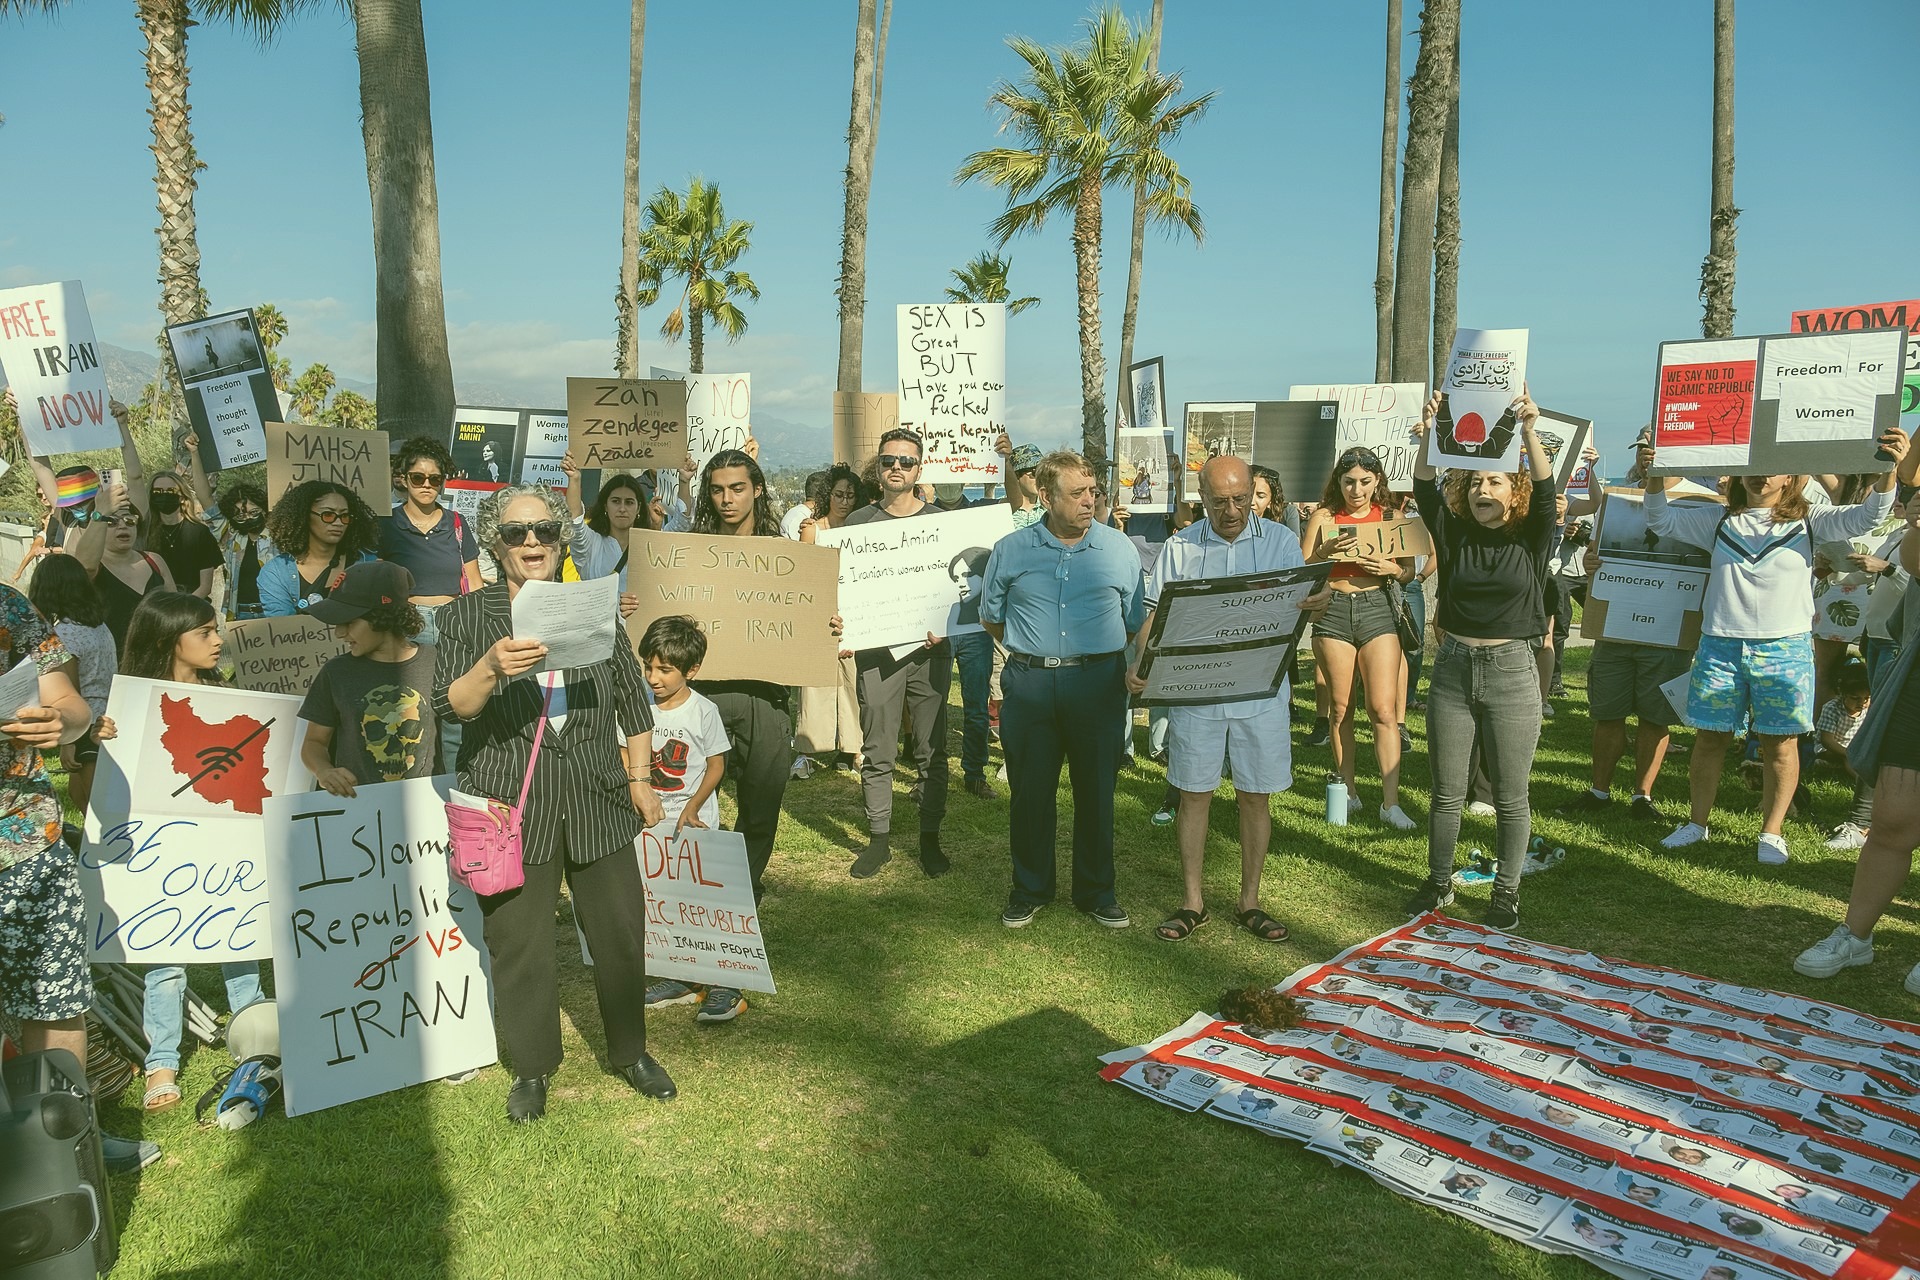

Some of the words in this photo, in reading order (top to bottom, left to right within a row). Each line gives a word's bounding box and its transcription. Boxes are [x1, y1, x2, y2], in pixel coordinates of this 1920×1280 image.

[0, 299, 56, 340] FREE
[909, 305, 951, 330] SEX
[911, 332, 959, 352] Great
[33, 342, 99, 376] IRAN
[920, 352, 977, 377] BUT
[1667, 371, 1681, 382] WE
[1684, 370, 1702, 381] SAY
[1705, 369, 1719, 380] NO
[1722, 368, 1734, 379] TO
[1776, 364, 1842, 377] Freedom
[1859, 362, 1883, 373] For
[206, 378, 242, 394] Freedom
[594, 386, 658, 406] Zan
[901, 378, 948, 400] Have
[958, 383, 977, 395] you
[983, 381, 1004, 391] ever
[1665, 384, 1704, 396] ISLAMIC
[1707, 381, 1754, 394] REPUBLIC
[224, 394, 233, 405] of
[712, 379, 749, 419] NO
[1665, 402, 1701, 412] #WOMAN-
[37, 390, 103, 430] NOW
[216, 407, 248, 423] thought
[1664, 413, 1682, 422] LIFE-
[1796, 408, 1855, 418] Women
[222, 422, 250, 438] speech
[460, 424, 485, 433] MAHSA
[689, 416, 704, 426] TO
[961, 421, 1006, 438] Republi
[1383, 415, 1418, 441] THE
[1663, 422, 1694, 431] FREEDOM
[236, 438, 245, 448] &
[285, 430, 372, 463] MAHSA
[459, 433, 481, 441] AMINI
[929, 440, 940, 453] of
[229, 450, 260, 463] religion
[292, 463, 365, 488] JINA
[647, 541, 689, 568] WE
[702, 544, 795, 577] STAND
[850, 565, 894, 583] Iranian's
[898, 566, 924, 576] women
[928, 560, 949, 571] voice
[1598, 572, 1664, 589] Democracy
[1677, 581, 1697, 592] For
[658, 585, 714, 602] WITH
[735, 588, 814, 605] WOMEN
[1221, 590, 1296, 608] SUPPORT
[1632, 612, 1655, 624] Iran
[229, 624, 264, 653] The
[268, 623, 335, 648] hardest
[746, 619, 794, 643] IRAN
[1215, 622, 1280, 638] IRANIAN
[240, 656, 309, 677] revenge
[315, 652, 328, 666] is
[1172, 660, 1232, 671] WOMEN'S
[1161, 681, 1236, 691] REVOLUTION
[80, 820, 198, 873] BE
[291, 809, 453, 892] Islam
[642, 831, 724, 888] DEAL
[162, 860, 265, 897] OUR
[95, 899, 269, 951] VOICE
[291, 887, 465, 958] Republic
[679, 902, 757, 935] REPUBLIC
[645, 930, 669, 948] ITH
[673, 936, 716, 952] IRANIAN
[720, 943, 766, 960] PEOPLE
[320, 974, 471, 1067] IRAN
